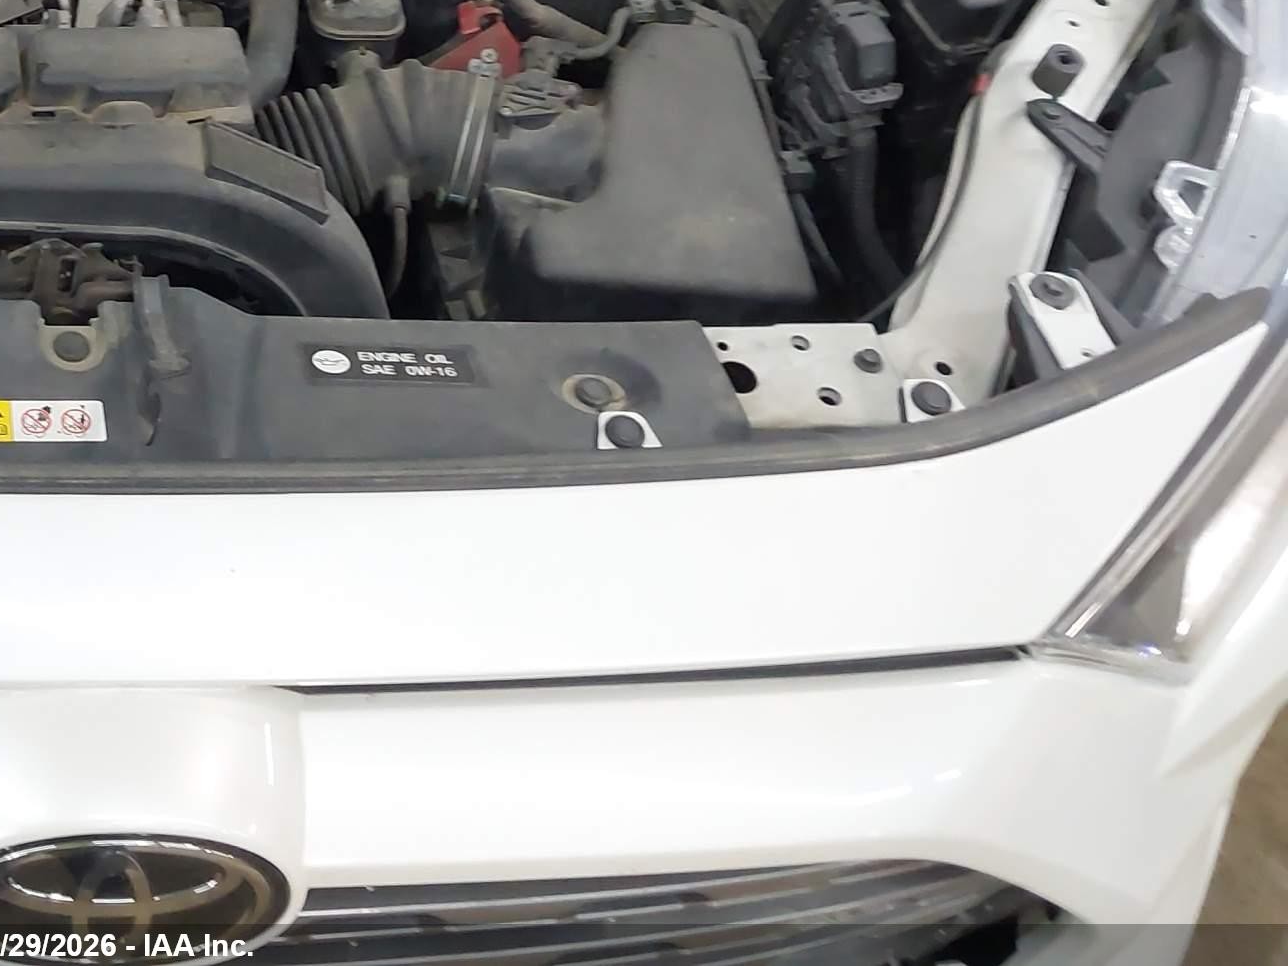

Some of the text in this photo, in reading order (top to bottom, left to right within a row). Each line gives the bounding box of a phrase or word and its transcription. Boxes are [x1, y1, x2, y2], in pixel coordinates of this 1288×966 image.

[356, 351, 454, 365] ENGINE OIL
[361, 364, 458, 377] SAE 0W-16
